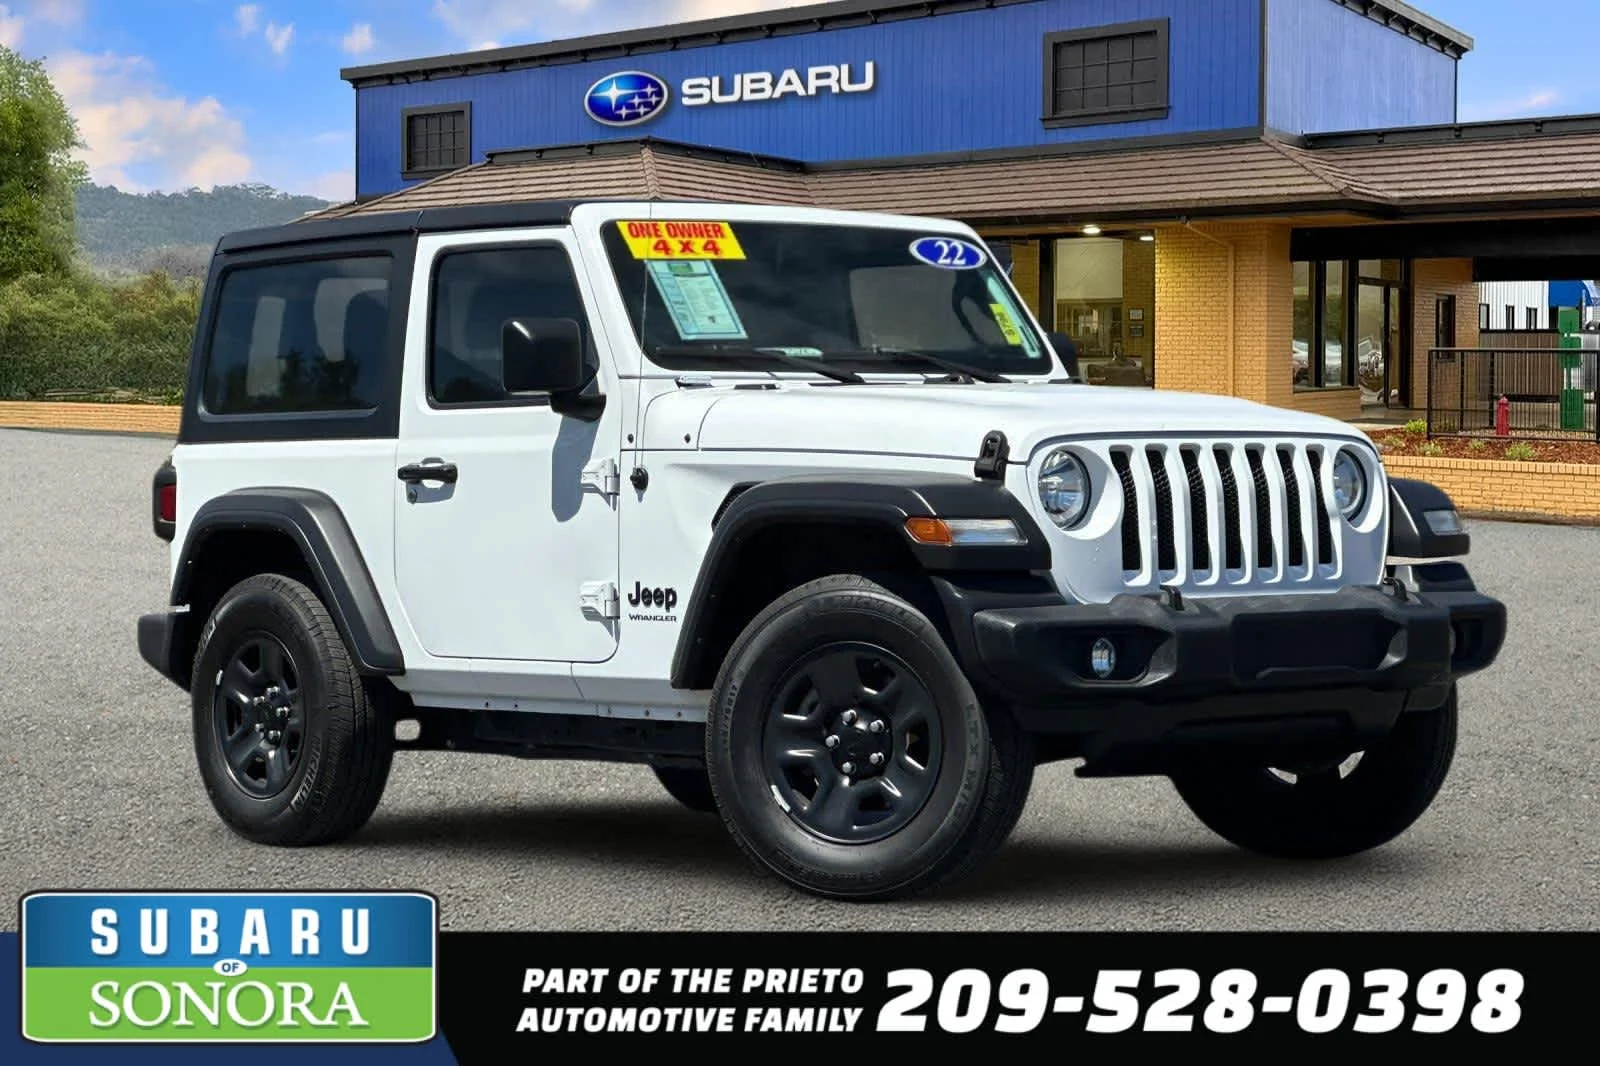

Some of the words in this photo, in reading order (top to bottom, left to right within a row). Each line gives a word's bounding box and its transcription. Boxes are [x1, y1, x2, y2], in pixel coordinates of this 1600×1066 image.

[681, 61, 876, 105] SUBARU
[628, 222, 661, 239] ONE
[665, 223, 725, 239] OWNER
[935, 240, 966, 265] 22
[627, 581, 678, 612] Jeep
[628, 613, 677, 622] WRANGLER
